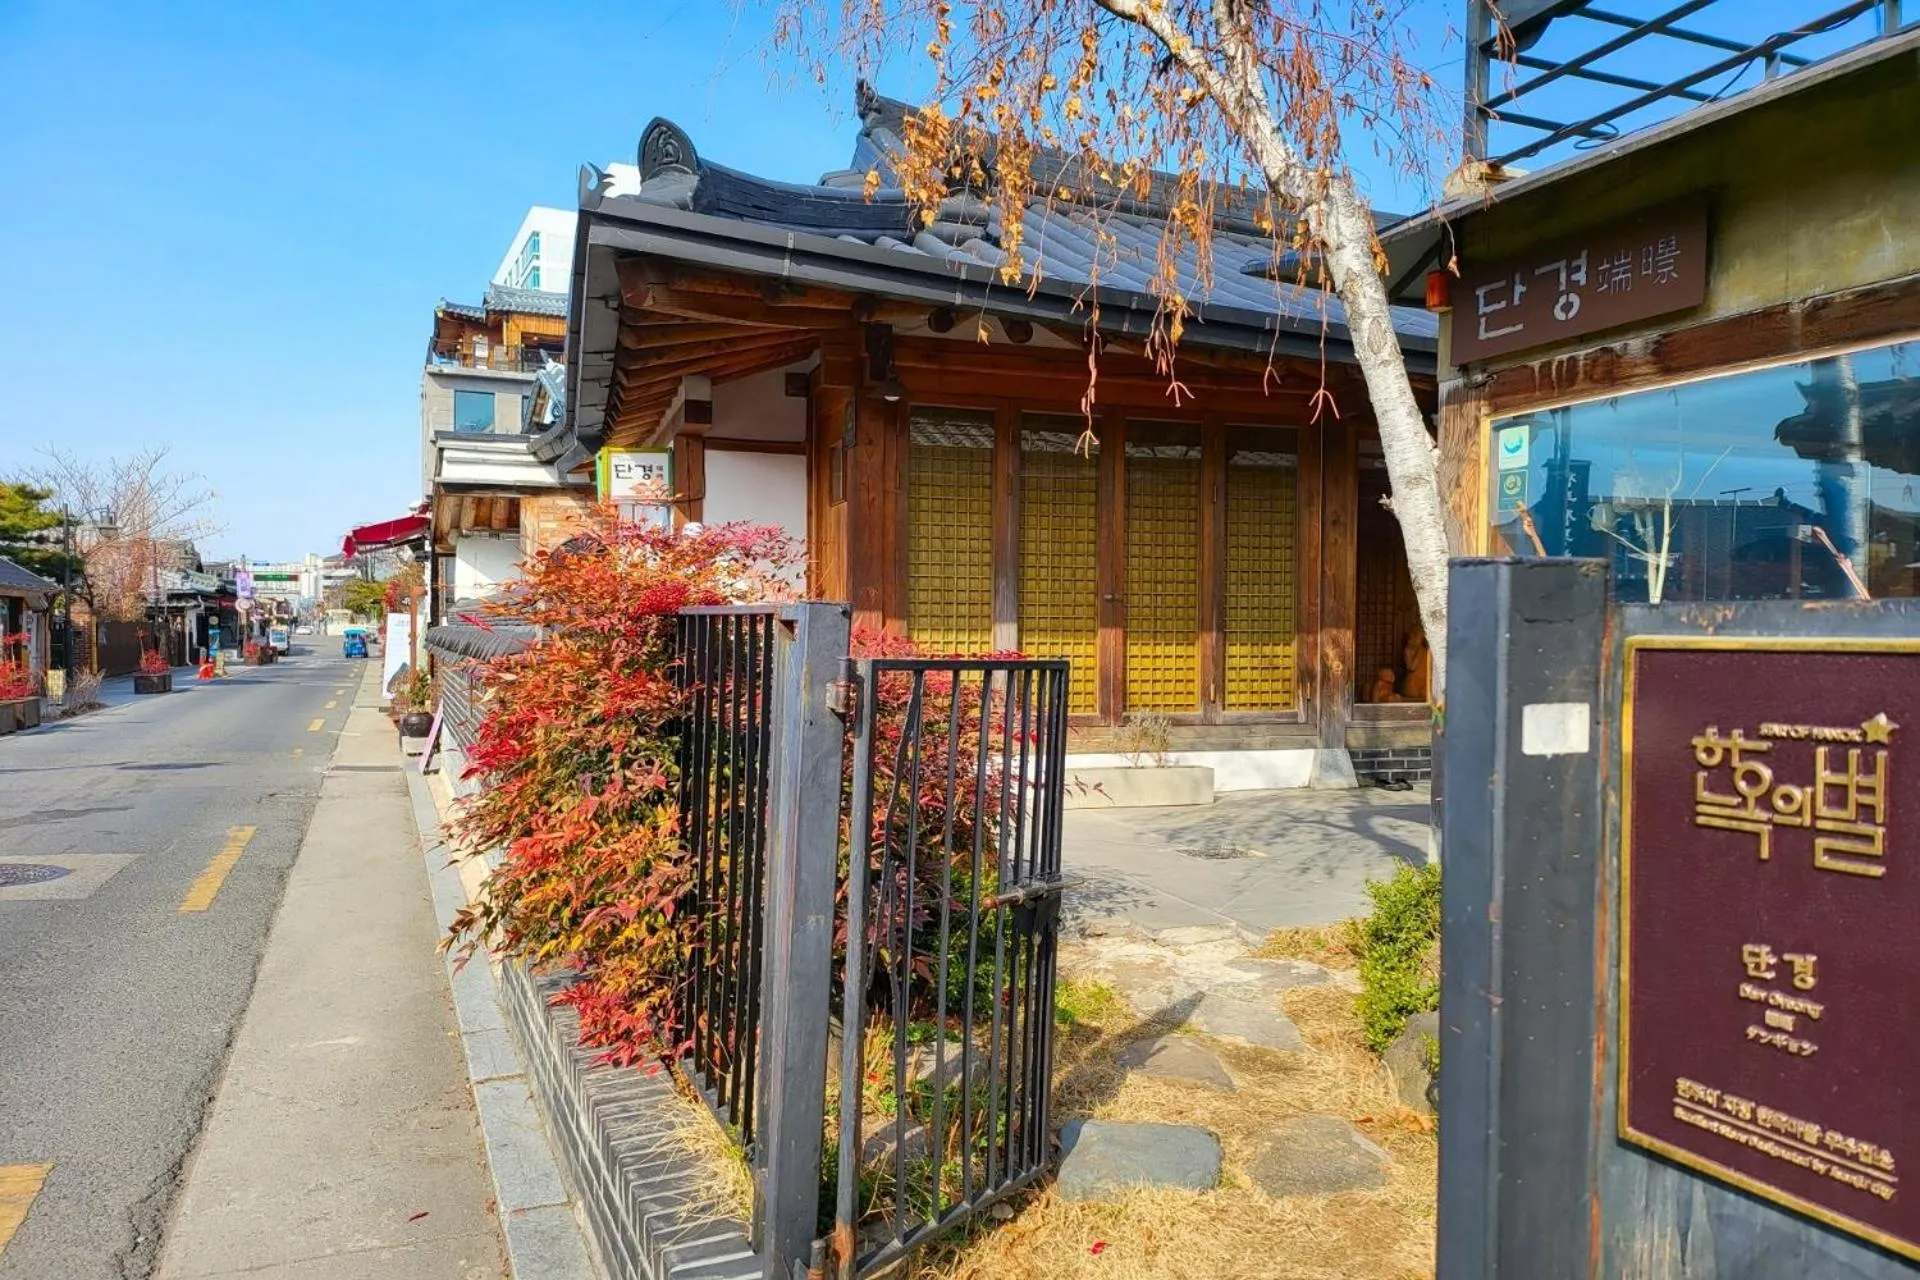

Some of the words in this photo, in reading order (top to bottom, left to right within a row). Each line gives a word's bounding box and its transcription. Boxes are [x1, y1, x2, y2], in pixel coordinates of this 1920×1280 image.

[1475, 249, 1588, 341] 단경
[614, 463, 653, 480] 단경
[1742, 944, 1818, 989] 단경
